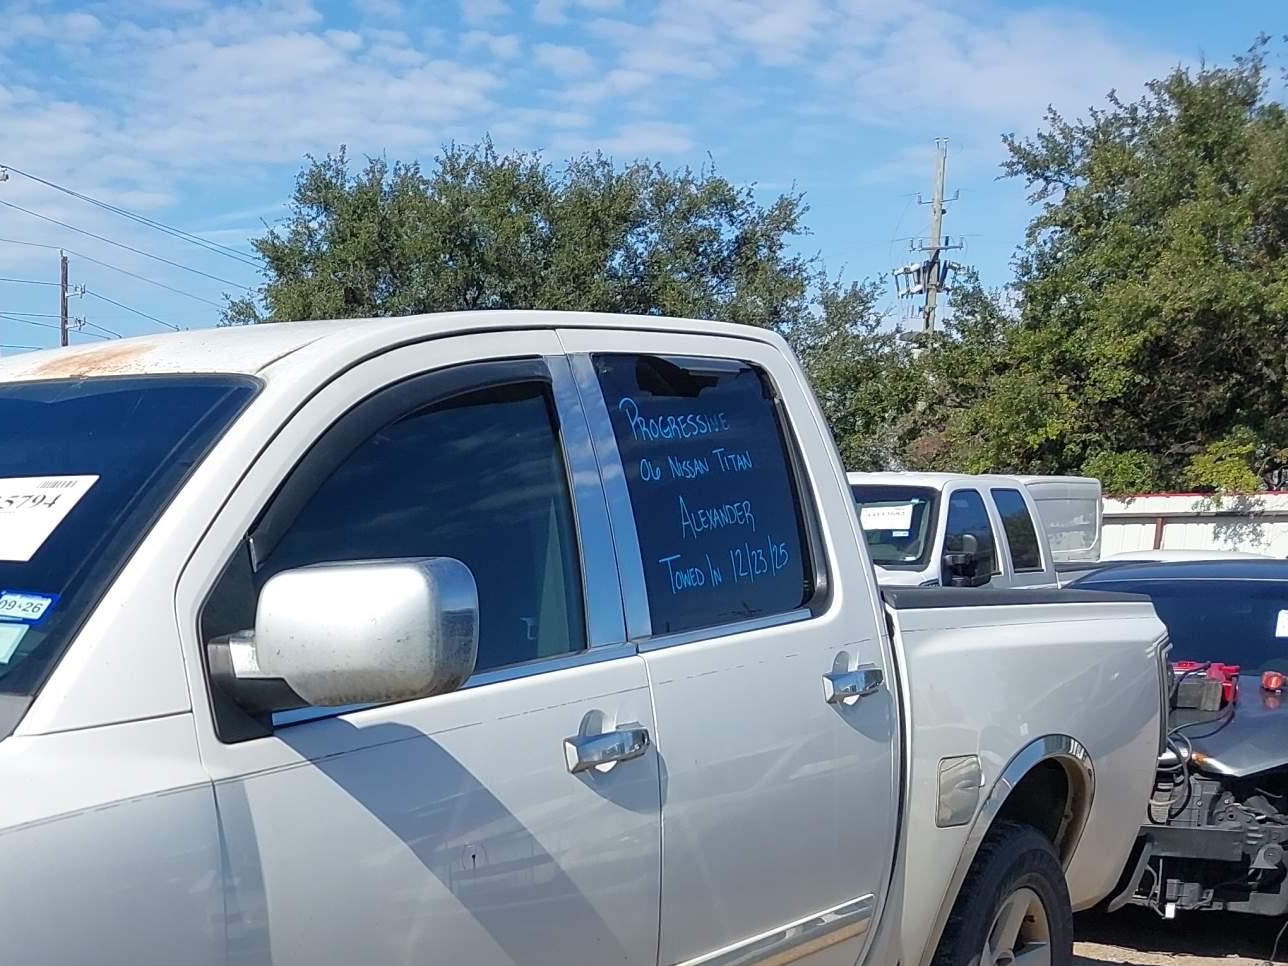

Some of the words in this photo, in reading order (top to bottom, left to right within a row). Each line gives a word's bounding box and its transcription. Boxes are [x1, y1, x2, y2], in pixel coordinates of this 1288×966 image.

[640, 459, 661, 481] 06
[668, 455, 710, 479] NISSAN
[712, 447, 753, 472] TITAN
[679, 496, 756, 539] ALEXANDER
[659, 554, 705, 594] TOWED
[729, 535, 789, 584] 12/23/25
